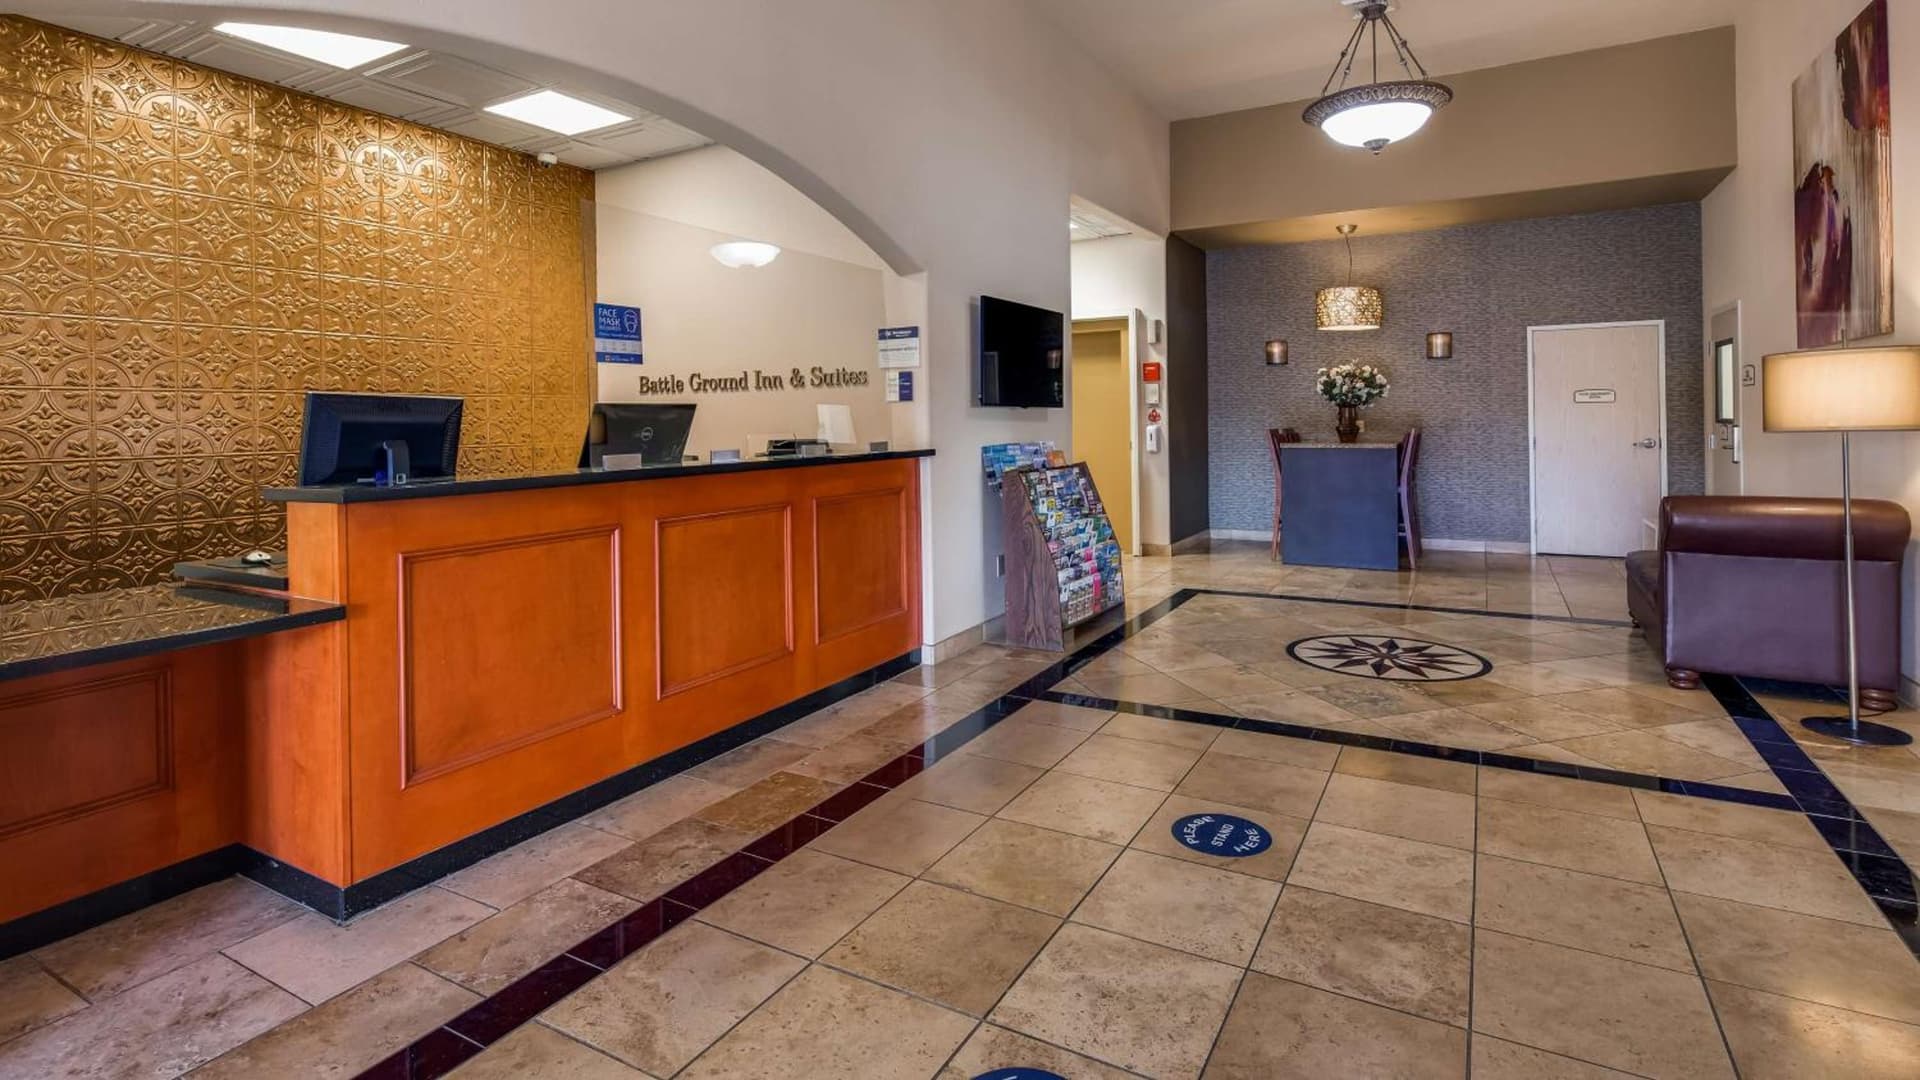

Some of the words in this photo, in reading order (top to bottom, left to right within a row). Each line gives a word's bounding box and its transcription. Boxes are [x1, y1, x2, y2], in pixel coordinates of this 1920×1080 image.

[598, 307, 617, 318] FACE
[598, 316, 621, 327] MASK
[639, 374, 684, 395] Battle
[689, 372, 749, 393] Ground
[754, 369, 784, 391] Inn
[790, 367, 805, 388] &
[810, 366, 868, 388] Suites
[1184, 815, 1216, 845] PLEASE
[1210, 823, 1235, 847] STAND
[1233, 827, 1261, 853] HERE
